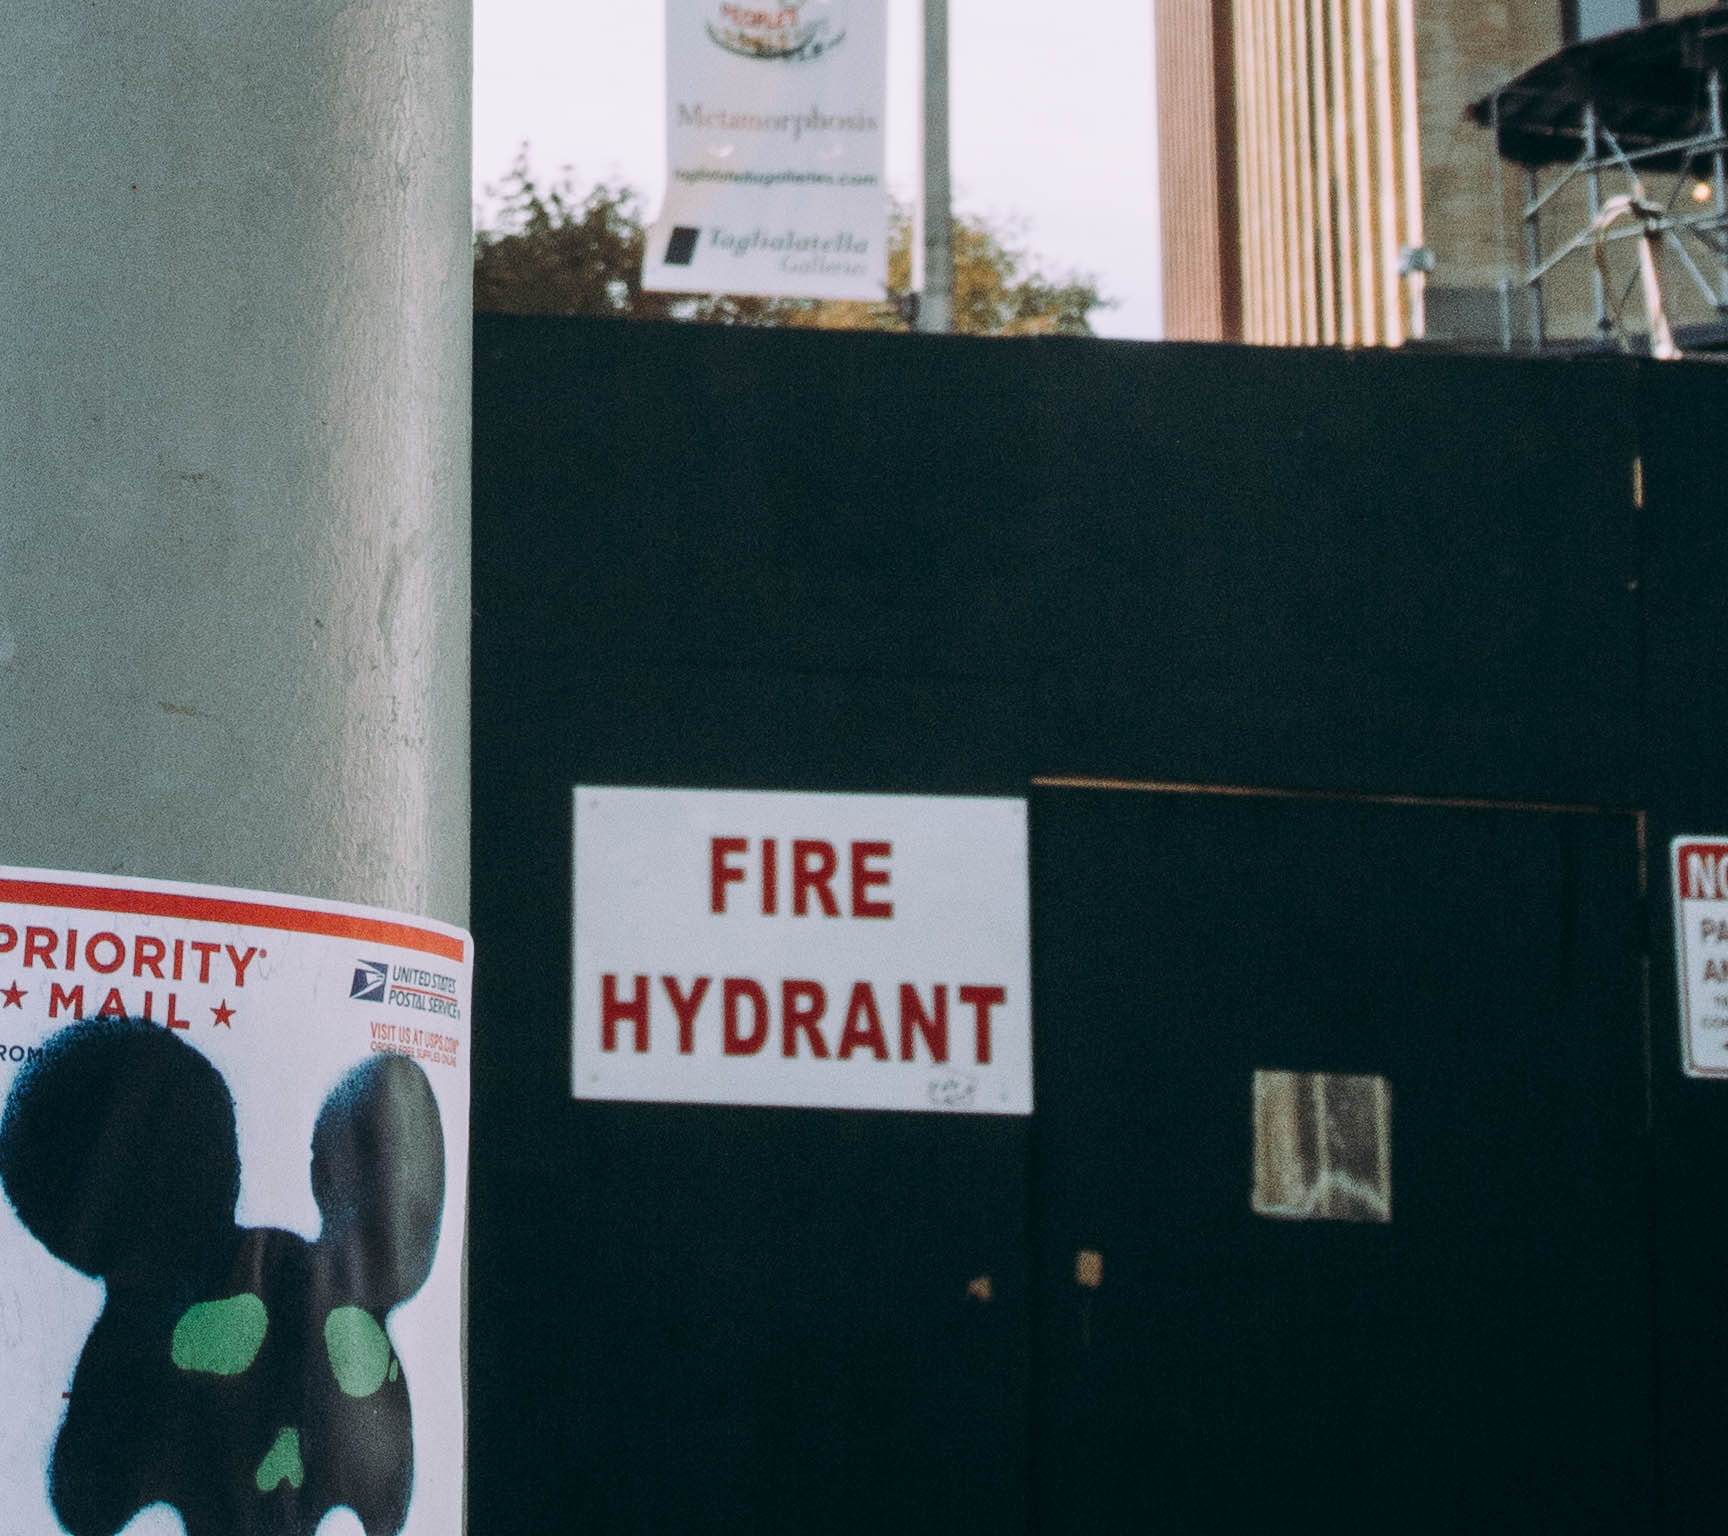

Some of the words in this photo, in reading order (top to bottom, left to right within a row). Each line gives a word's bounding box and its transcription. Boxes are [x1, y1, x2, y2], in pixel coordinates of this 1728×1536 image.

[709, 836, 895, 919] FIRE
[392, 964, 431, 987] UNITED
[431, 974, 456, 994] STATES
[48, 982, 191, 1030] MAIL
[388, 989, 426, 1010] POSTAL
[600, 973, 1007, 1065] HYDRANT
[370, 1021, 396, 1041] VISIT
[399, 1026, 411, 1044] US
[413, 1029, 423, 1046] AT
